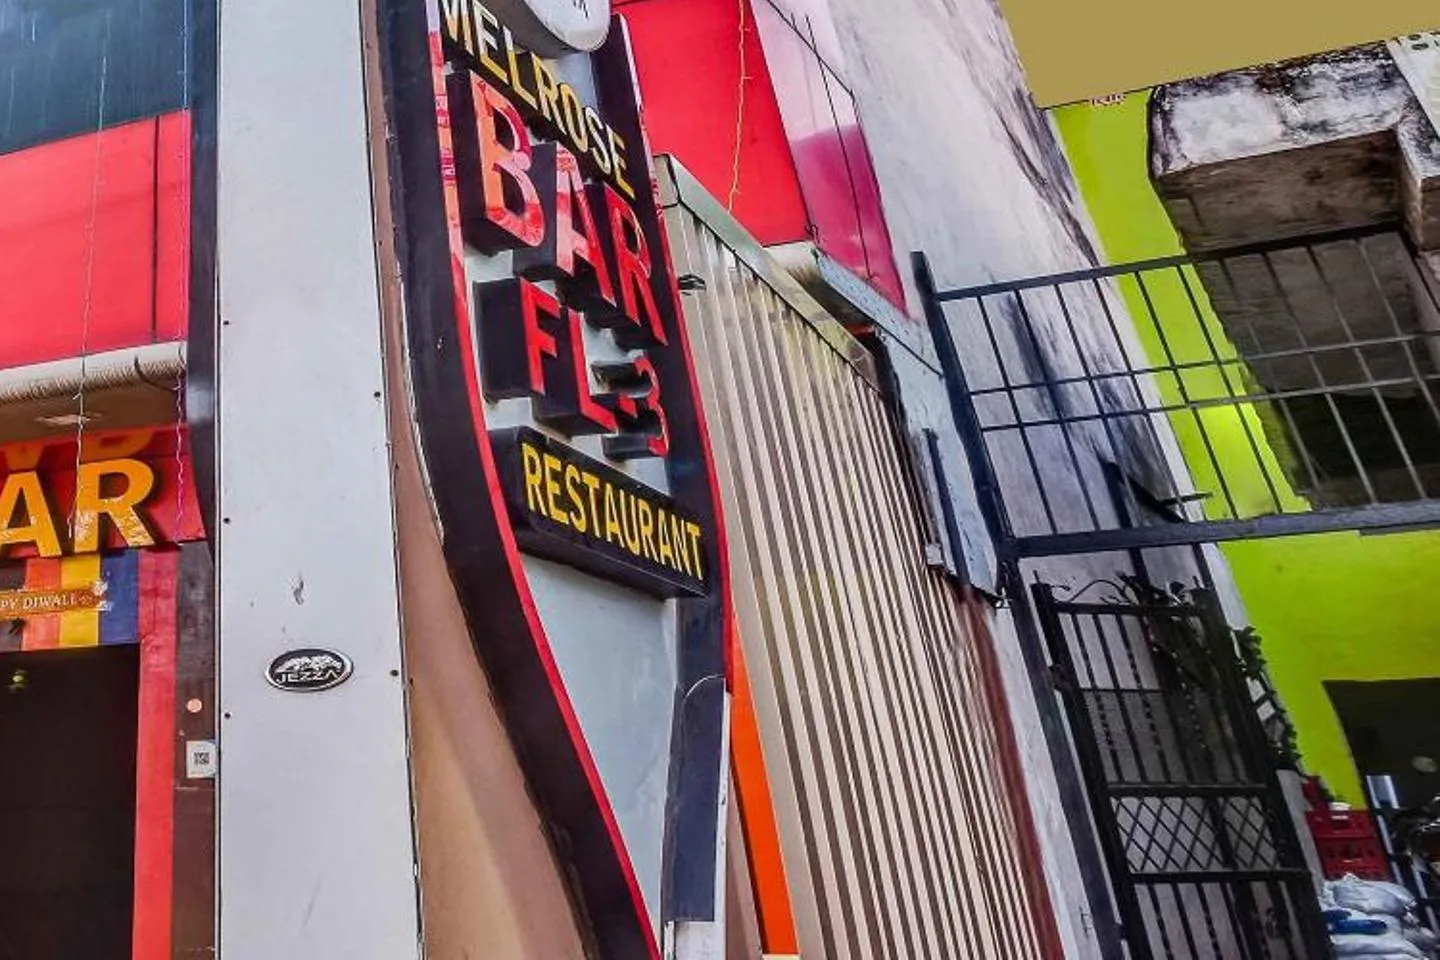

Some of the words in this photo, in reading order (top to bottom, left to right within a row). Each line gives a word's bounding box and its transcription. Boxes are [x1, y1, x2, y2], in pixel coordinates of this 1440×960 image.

[470, 70, 669, 346] BAR
[521, 442, 705, 582] RESTAURANT
[22, 596, 77, 610] DIWALI
